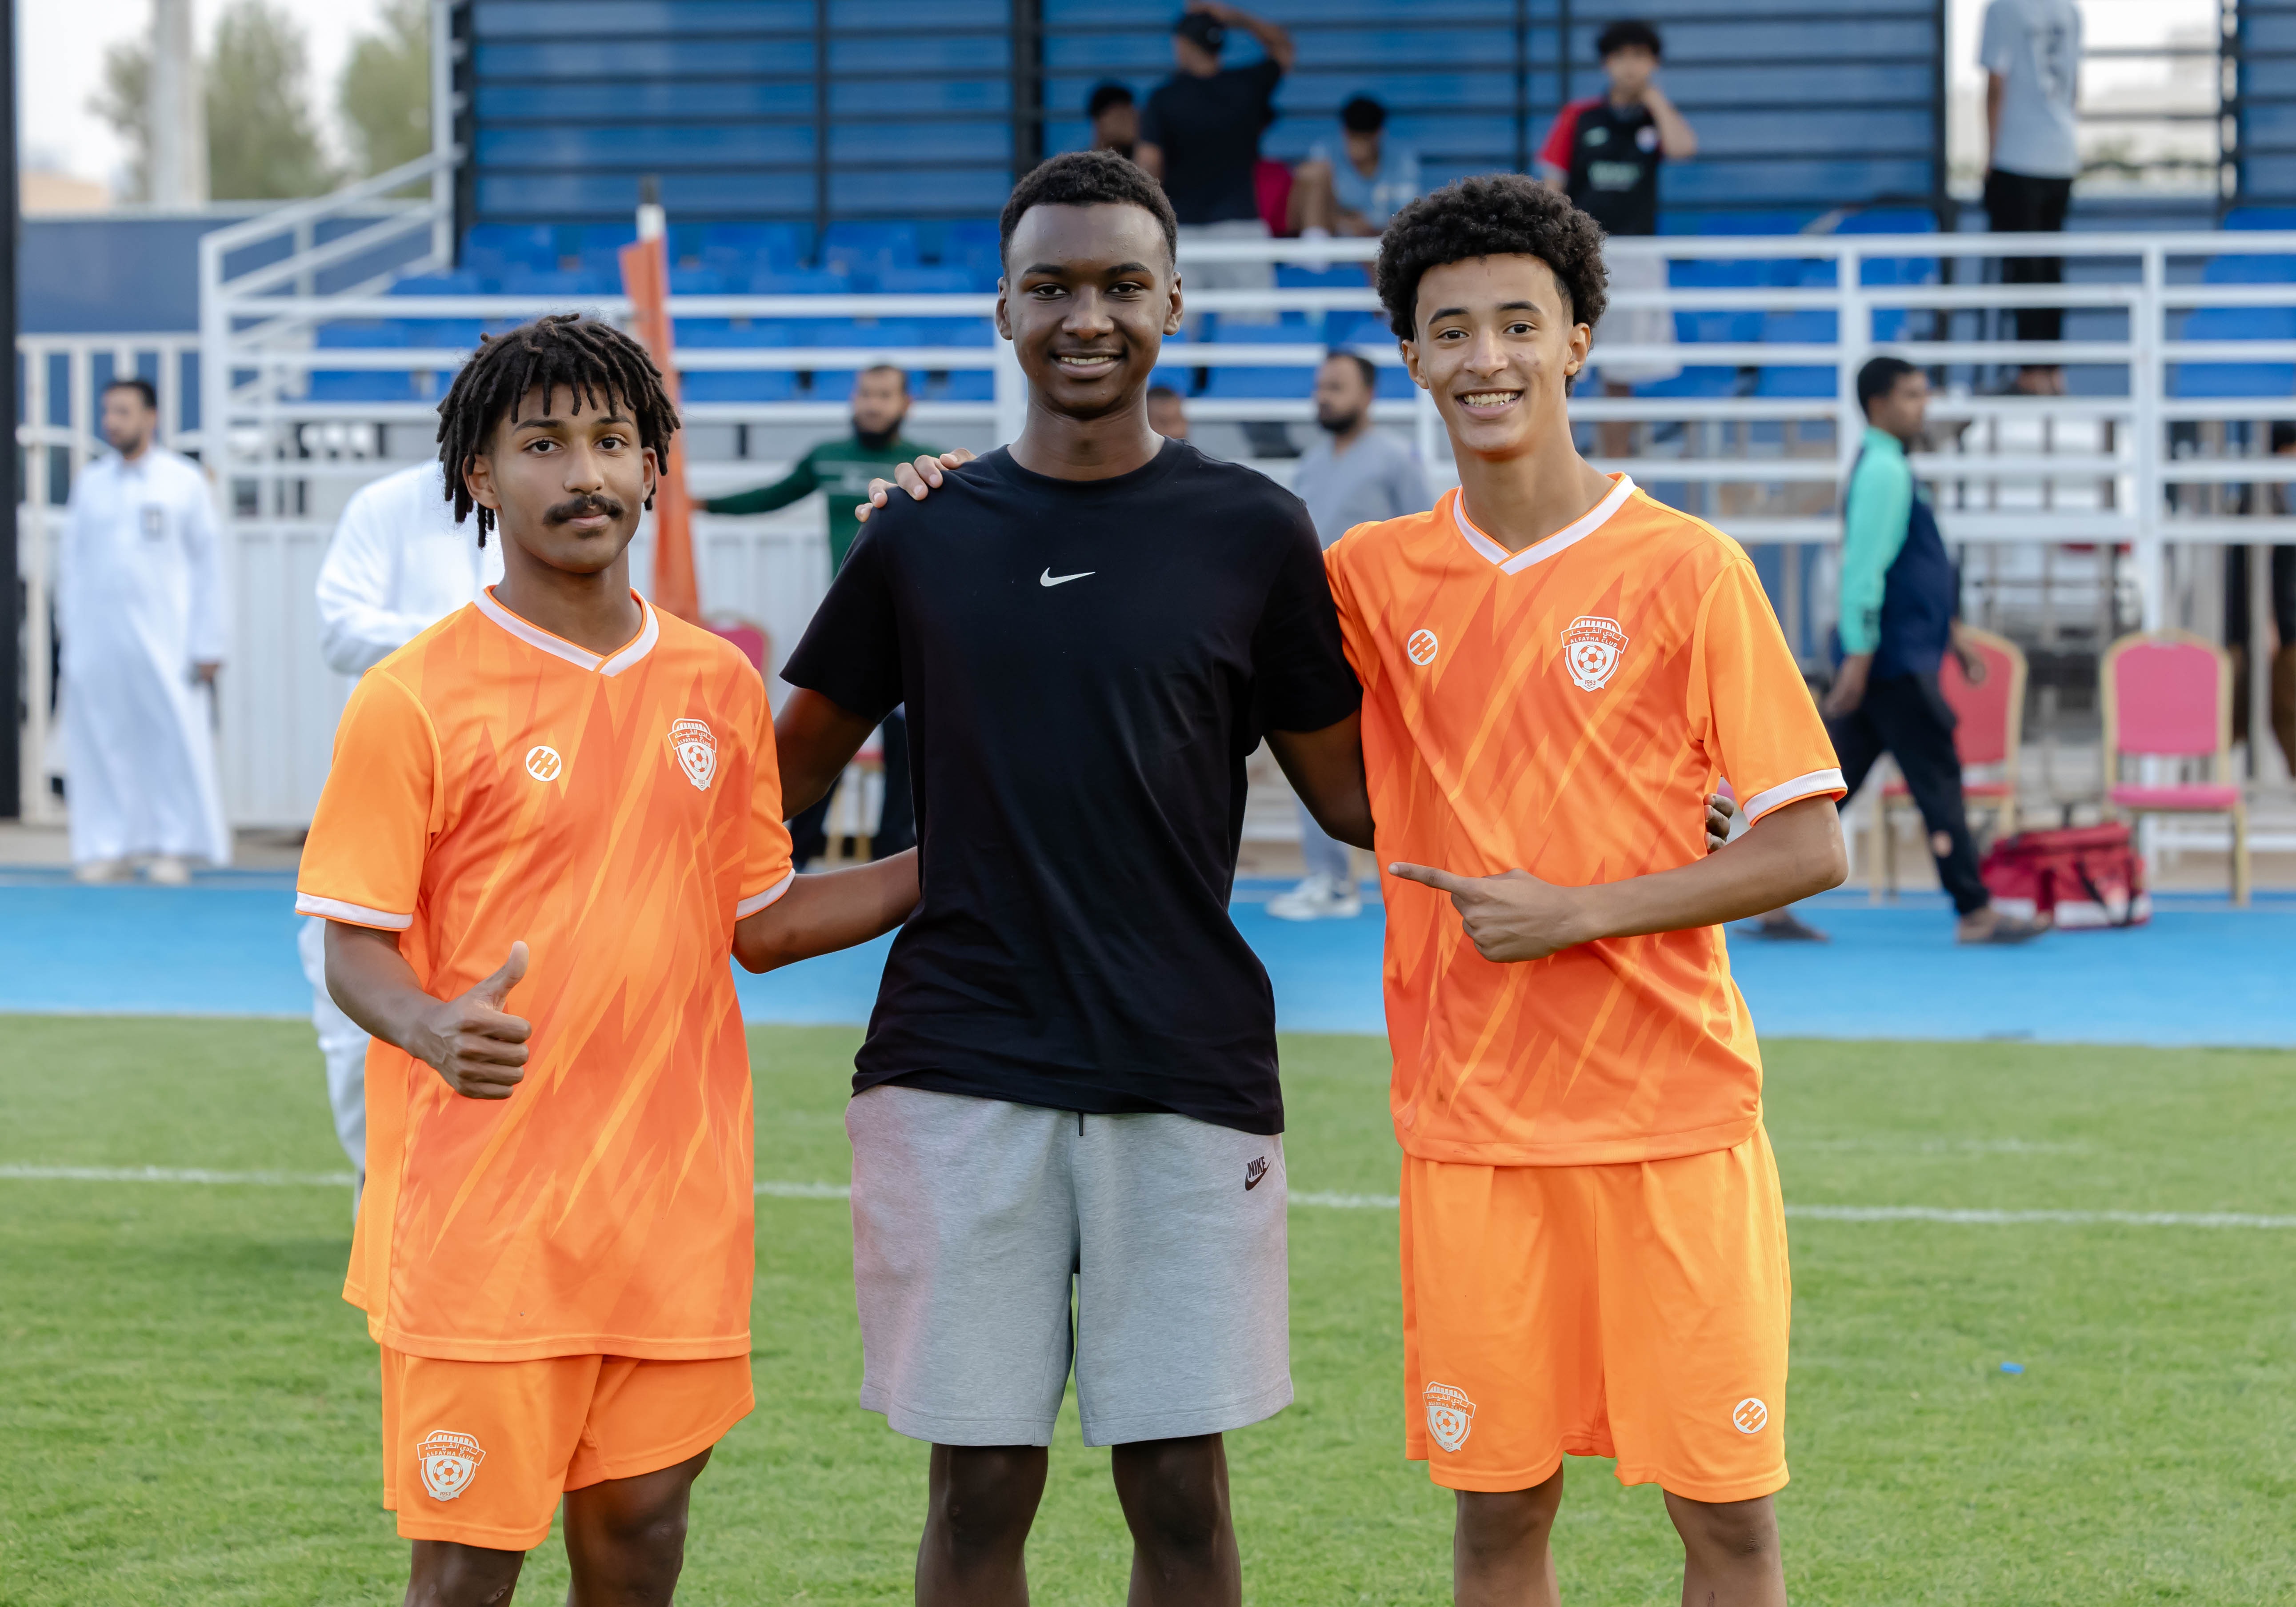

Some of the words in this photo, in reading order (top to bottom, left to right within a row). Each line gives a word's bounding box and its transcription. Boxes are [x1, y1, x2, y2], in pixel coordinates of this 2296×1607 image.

[1569, 627, 1602, 637] الفيحاء
[1603, 631, 1622, 641] نادي
[1570, 636, 1599, 644] ALFAYHA
[1601, 638, 1618, 648] CLUB
[700, 739, 711, 748] CLUB
[1247, 1156, 1266, 1178] NIKE
[1451, 1405, 1467, 1413] CLUB
